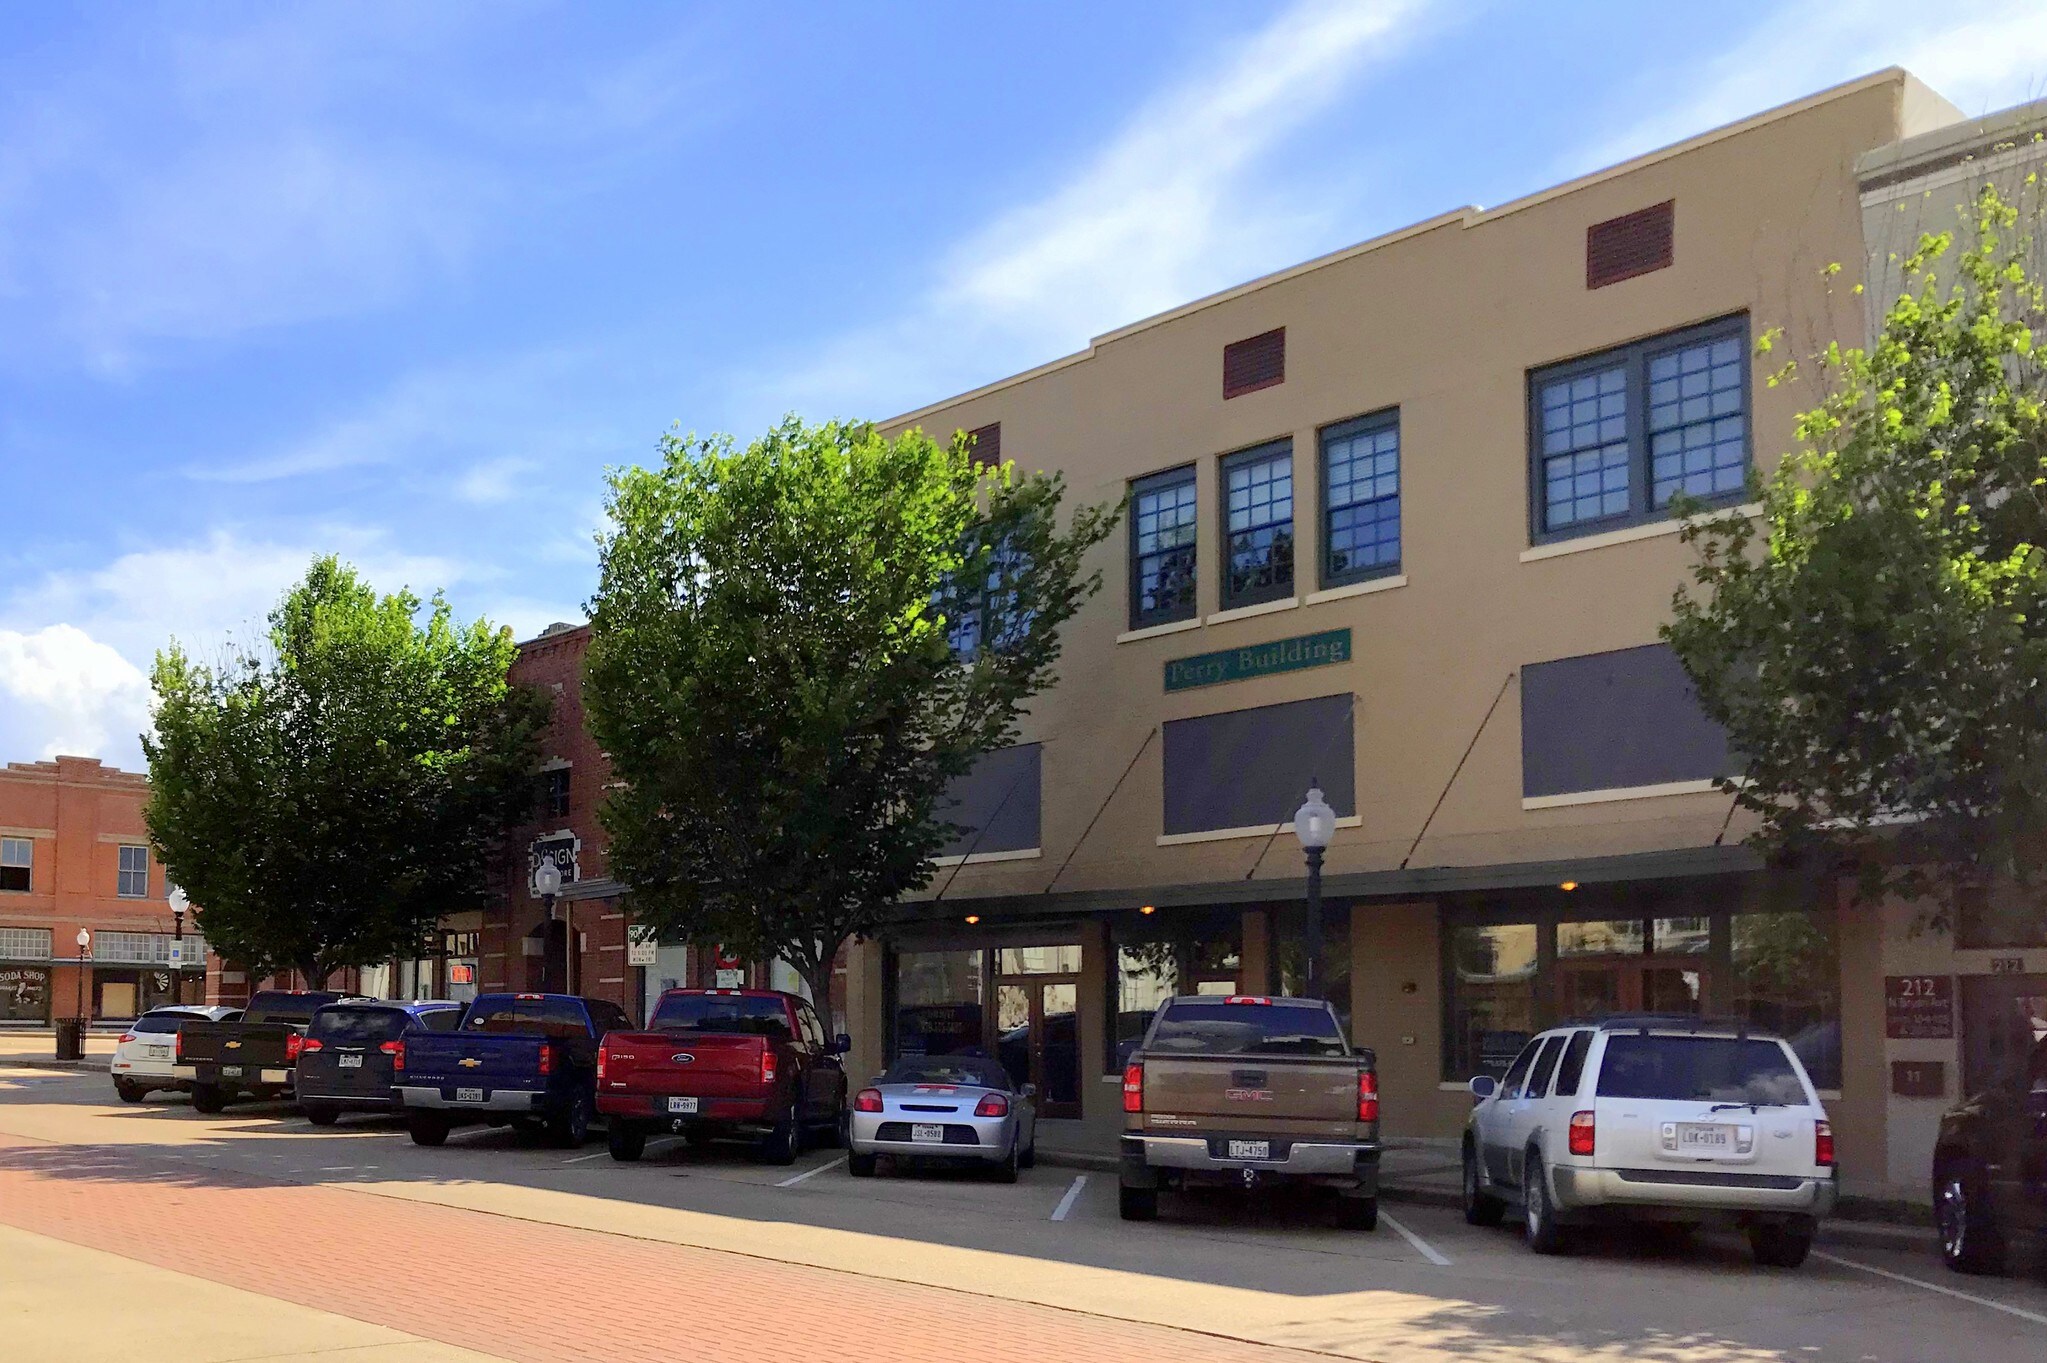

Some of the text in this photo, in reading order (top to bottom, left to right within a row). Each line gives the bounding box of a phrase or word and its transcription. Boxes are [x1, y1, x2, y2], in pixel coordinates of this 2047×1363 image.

[1171, 640, 1344, 683] Perry Building
[532, 848, 577, 868] DIGN
[0, 970, 46, 982] SODA SHOP
[1902, 979, 1936, 996] 212
[1225, 1089, 1274, 1101] GMC
